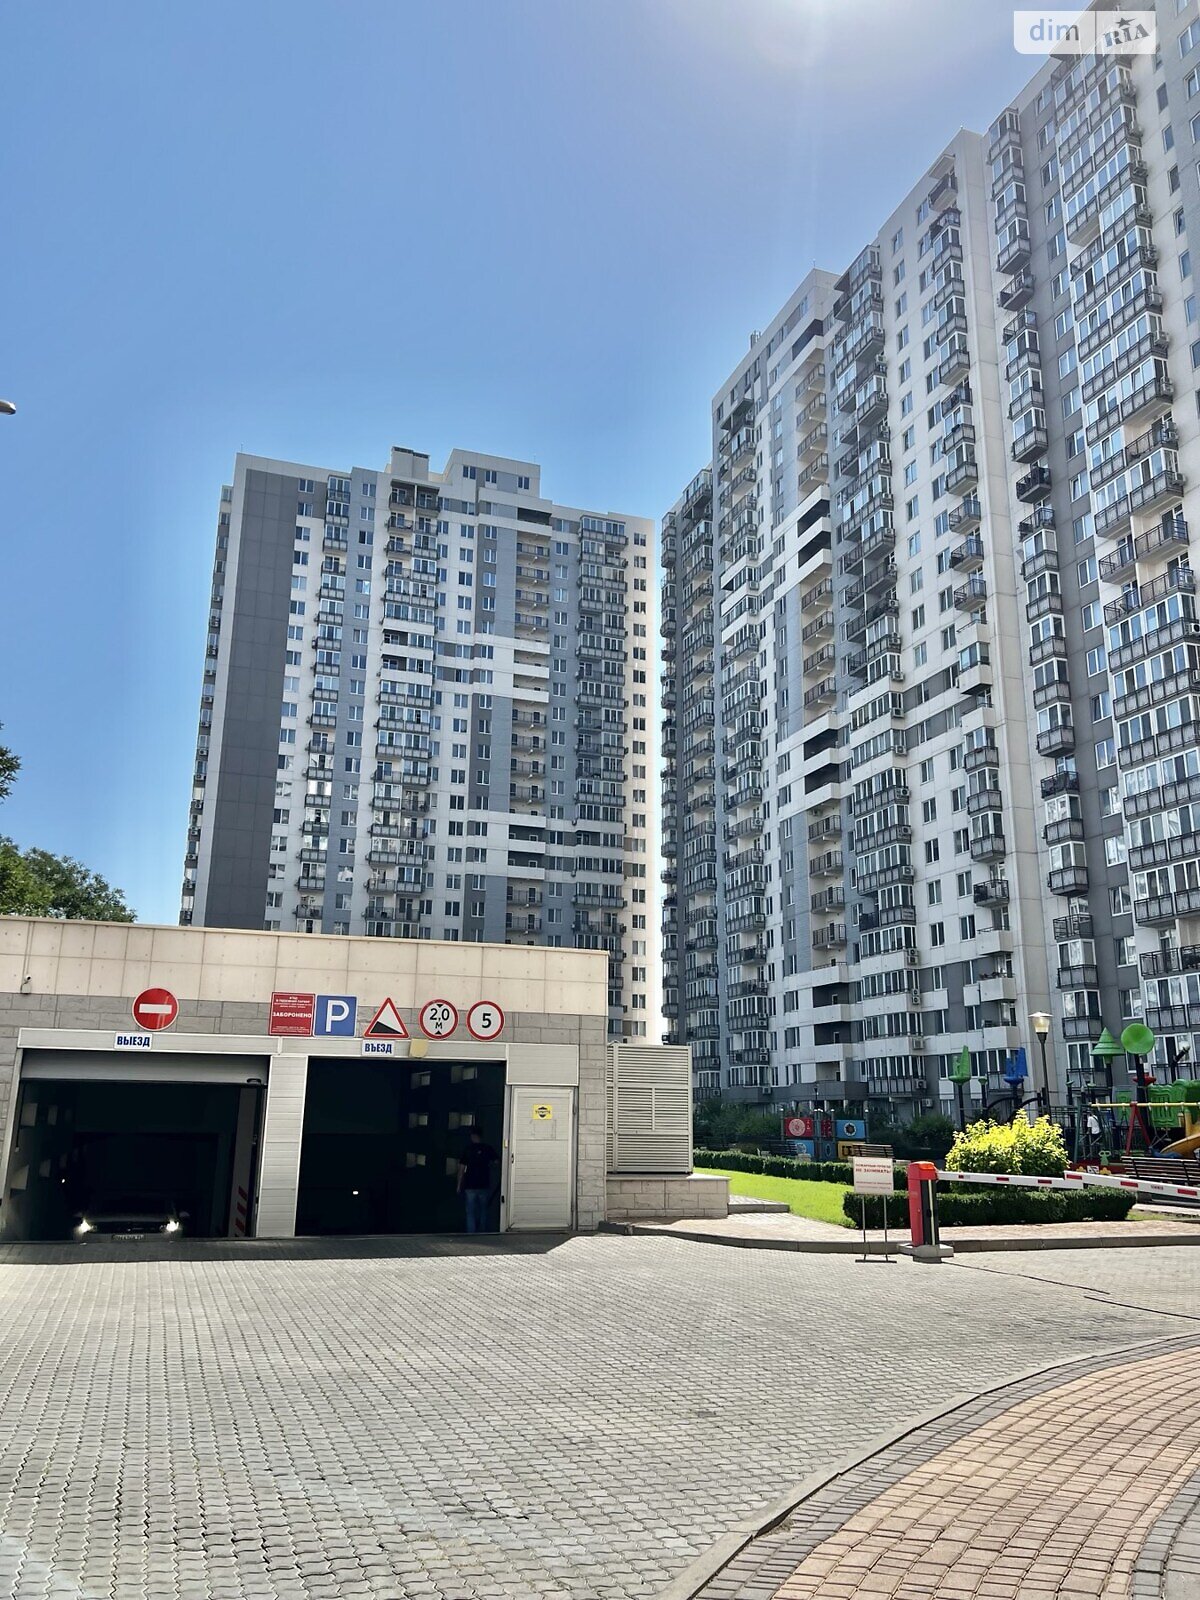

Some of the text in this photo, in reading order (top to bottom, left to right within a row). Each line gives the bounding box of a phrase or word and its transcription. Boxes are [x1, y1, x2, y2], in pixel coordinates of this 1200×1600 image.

[325, 1000, 349, 1033] P
[430, 1007, 450, 1021] 2,0
[482, 1013, 492, 1028] 5
[116, 1035, 150, 1047] ВЫЕЗД
[364, 1043, 392, 1054] ВЪЕЗД
